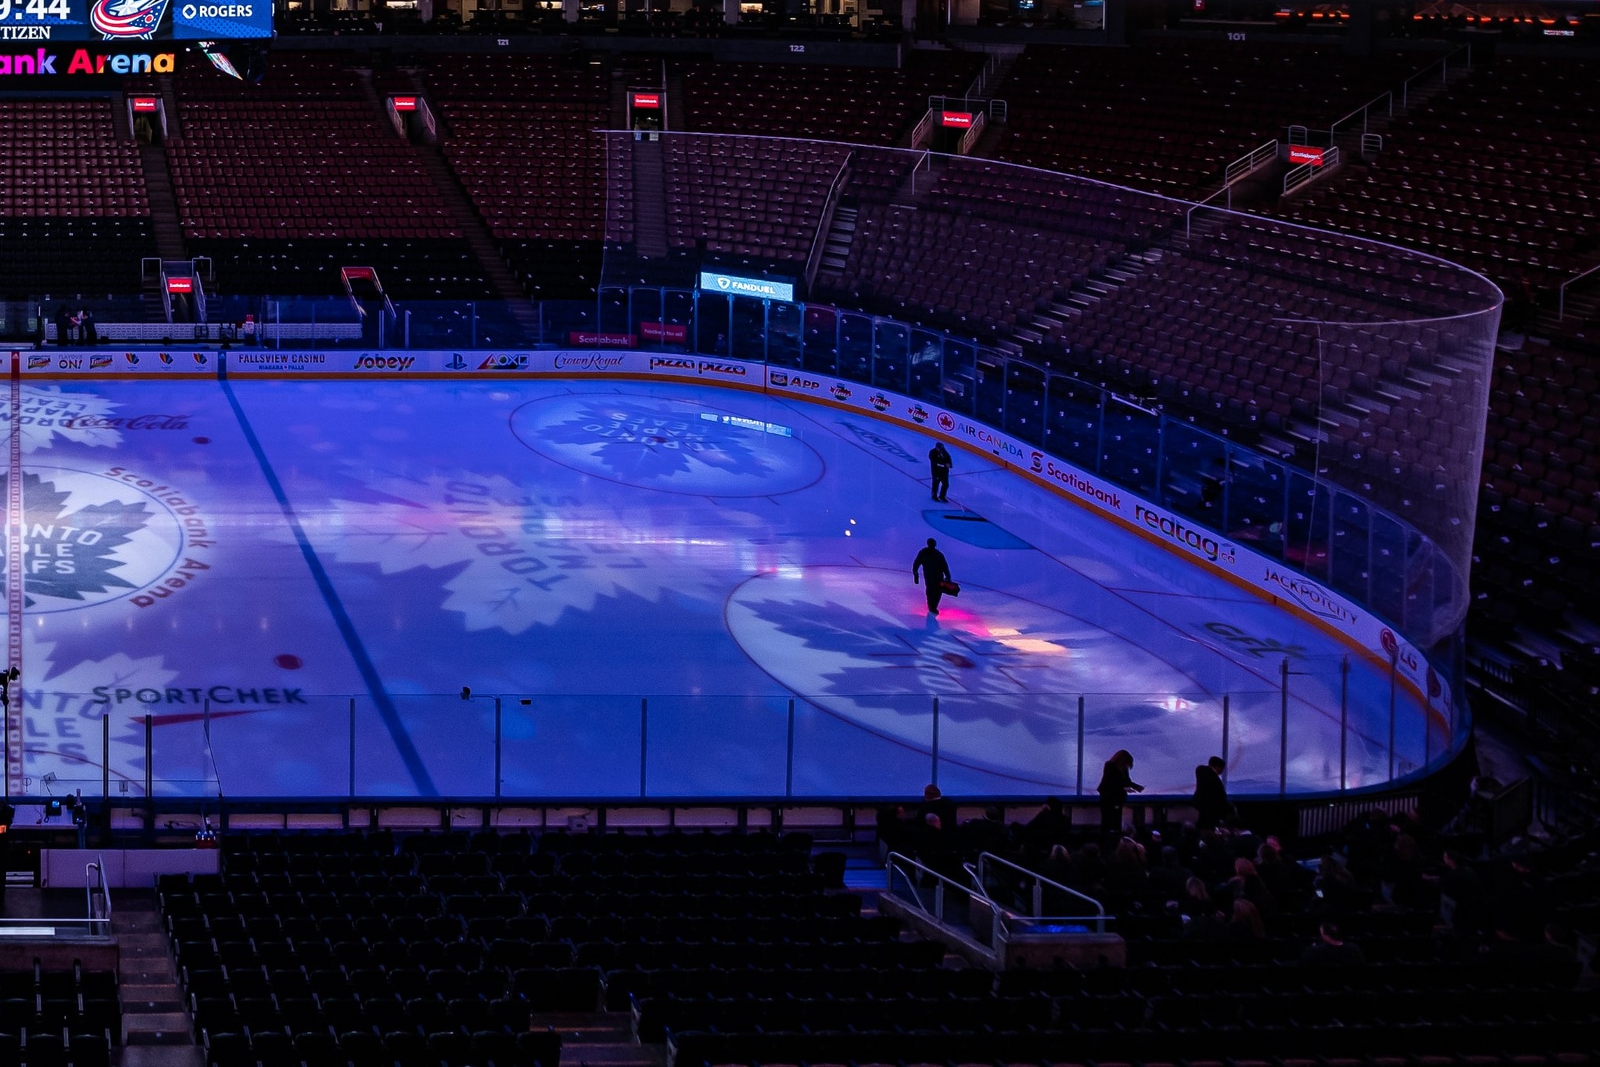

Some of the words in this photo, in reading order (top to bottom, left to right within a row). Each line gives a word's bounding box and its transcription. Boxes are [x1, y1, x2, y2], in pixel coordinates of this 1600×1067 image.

[199, 5, 252, 18] ROGERS
[1227, 32, 1246, 41] 101
[68, 47, 175, 75] Arena
[732, 281, 775, 294] FANDUEL
[239, 354, 290, 363] FALLSVIEW
[291, 354, 325, 363] CASINO
[354, 354, 415, 371] Sobeys
[554, 352, 589, 369] Crown
[587, 352, 626, 370] Royal
[649, 357, 695, 370] pizza
[698, 360, 746, 375] pizza
[957, 421, 976, 438] AIR
[977, 430, 1024, 460] CANADA
[1047, 462, 1121, 510] Scotiabank
[129, 556, 212, 610] Arena
[1264, 566, 1358, 625] JACKPOTCITY
[1400, 653, 1418, 671] LG
